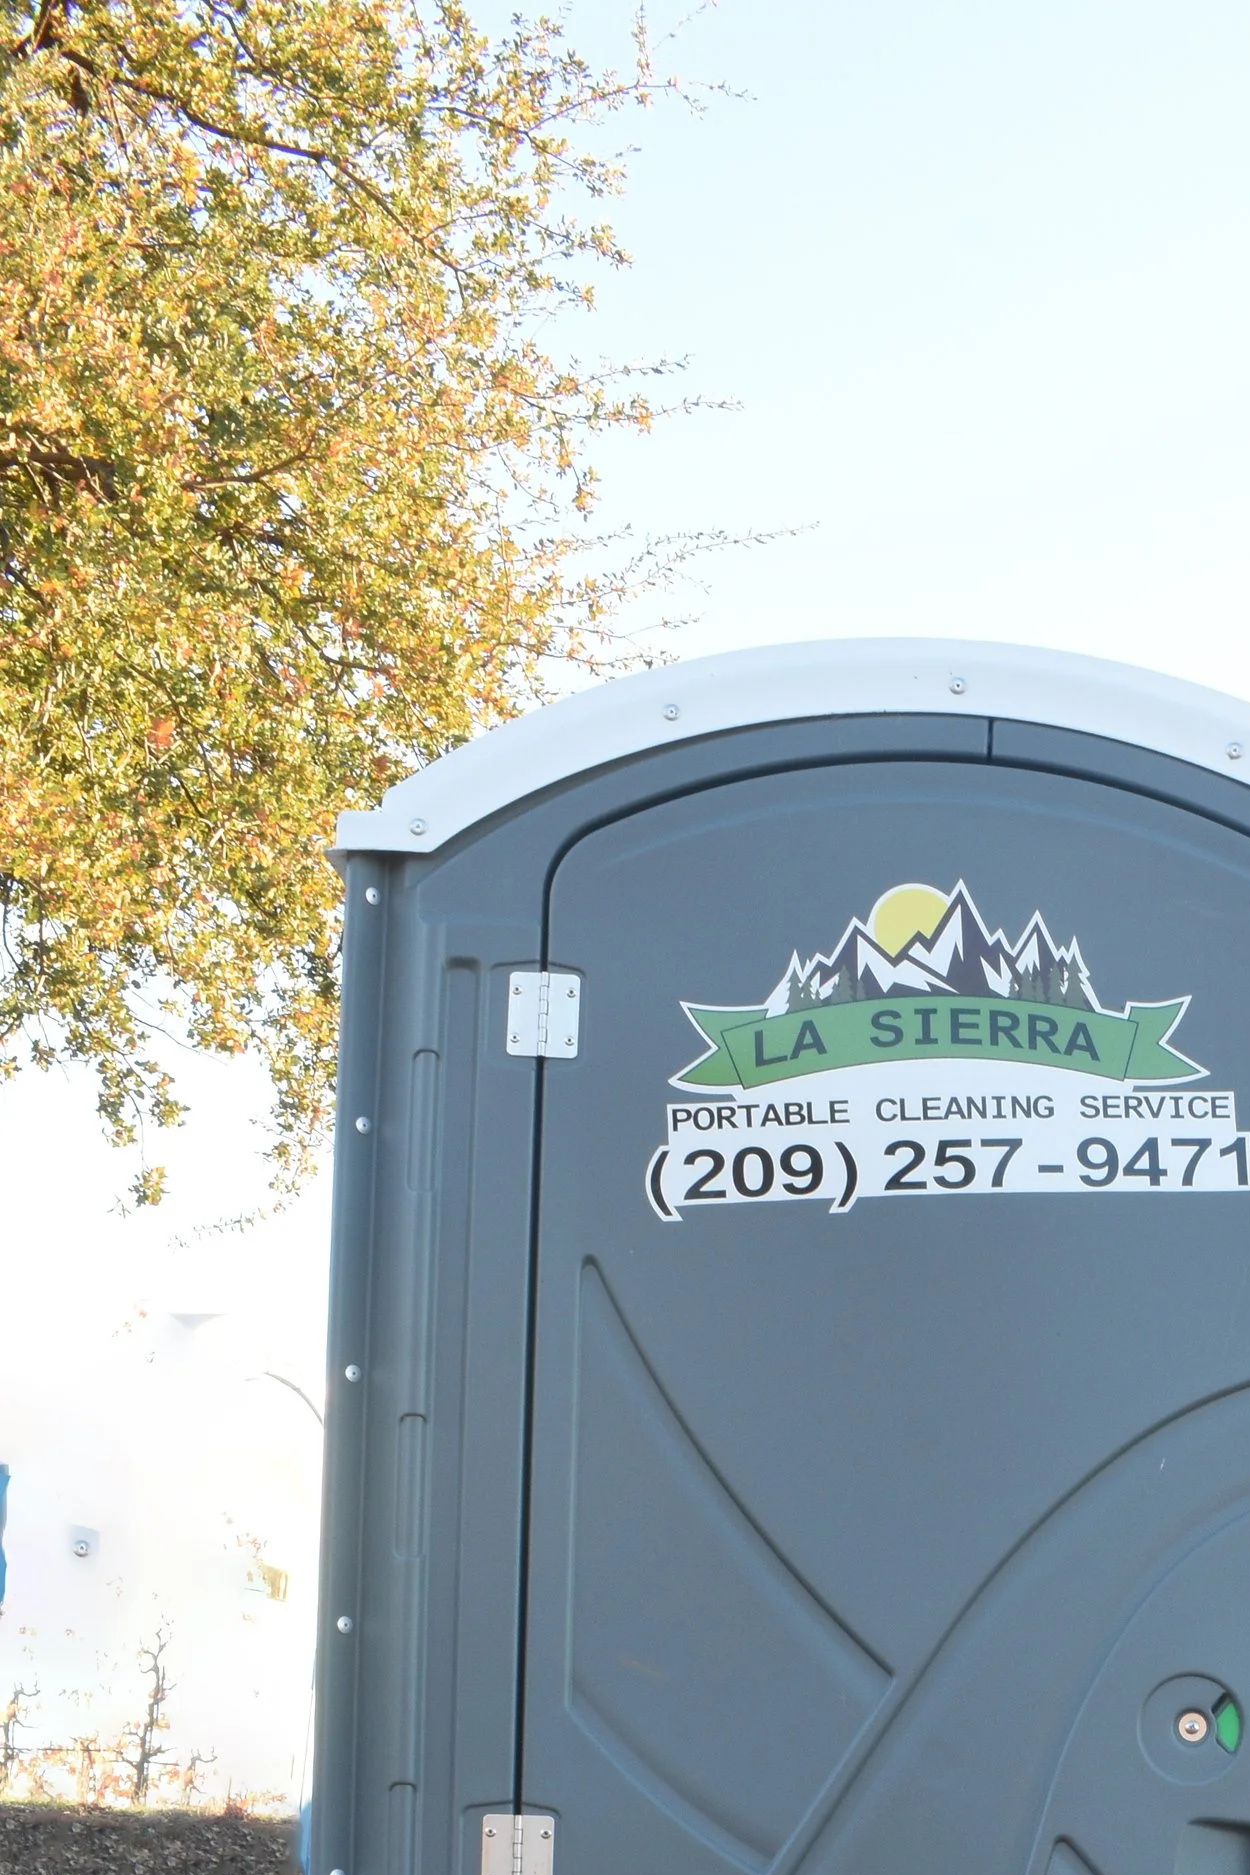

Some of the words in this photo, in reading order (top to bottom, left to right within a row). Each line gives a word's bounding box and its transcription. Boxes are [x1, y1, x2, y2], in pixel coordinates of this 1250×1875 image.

[754, 1019, 828, 1067] LA
[869, 1007, 1100, 1062] SIERRA
[671, 1100, 850, 1132] PORTABLE
[875, 1095, 1055, 1122] CLEANING
[1079, 1095, 1231, 1119] SERVICE
[650, 1141, 858, 1217] (209)
[883, 1136, 1249, 1192] 257-9471
